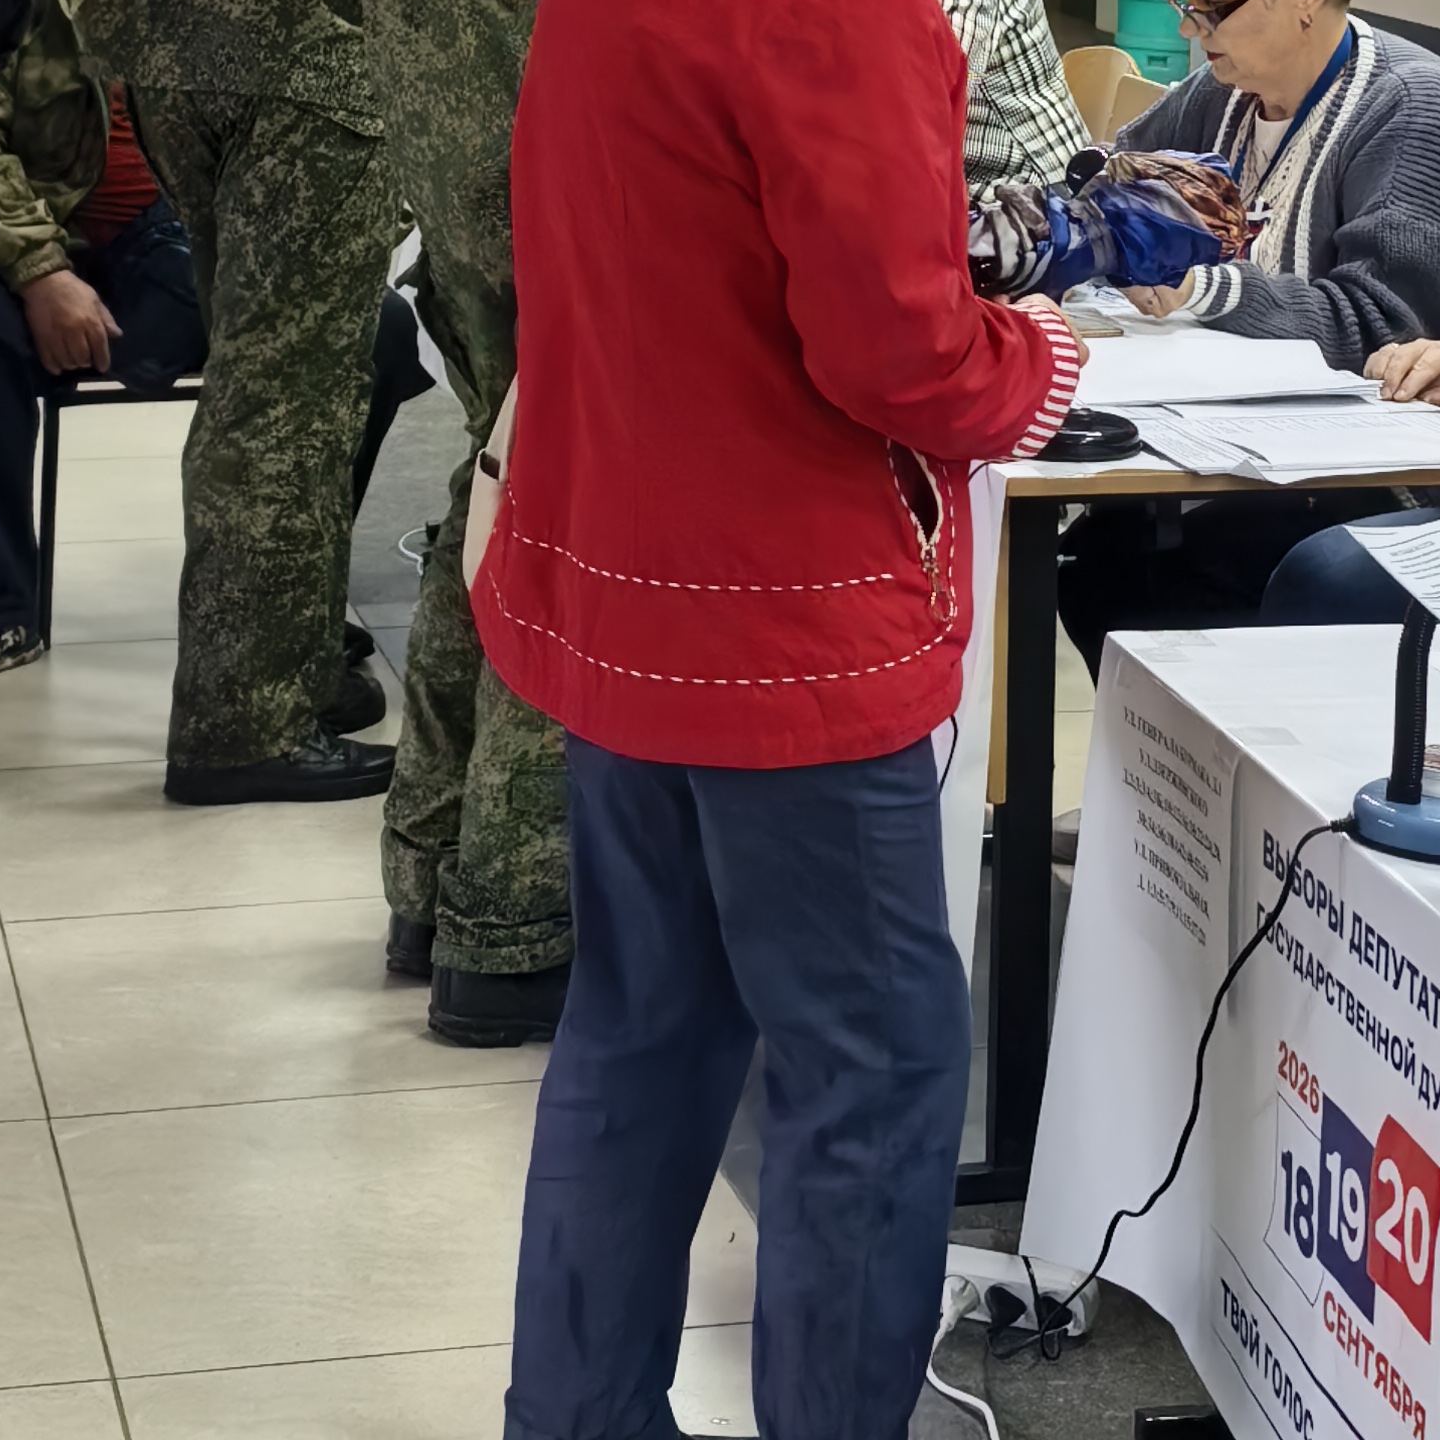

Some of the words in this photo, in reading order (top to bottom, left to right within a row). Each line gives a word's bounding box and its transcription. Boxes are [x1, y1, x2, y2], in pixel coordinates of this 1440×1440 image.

[1262, 828, 1345, 940] ВЫБОРЫ
[1277, 1039, 1320, 1114] 2026
[1280, 1149, 1316, 1260] 18
[1325, 1151, 1367, 1263] 19
[1374, 1157, 1431, 1287] 20
[1219, 1276, 1261, 1368] ТВОЙ
